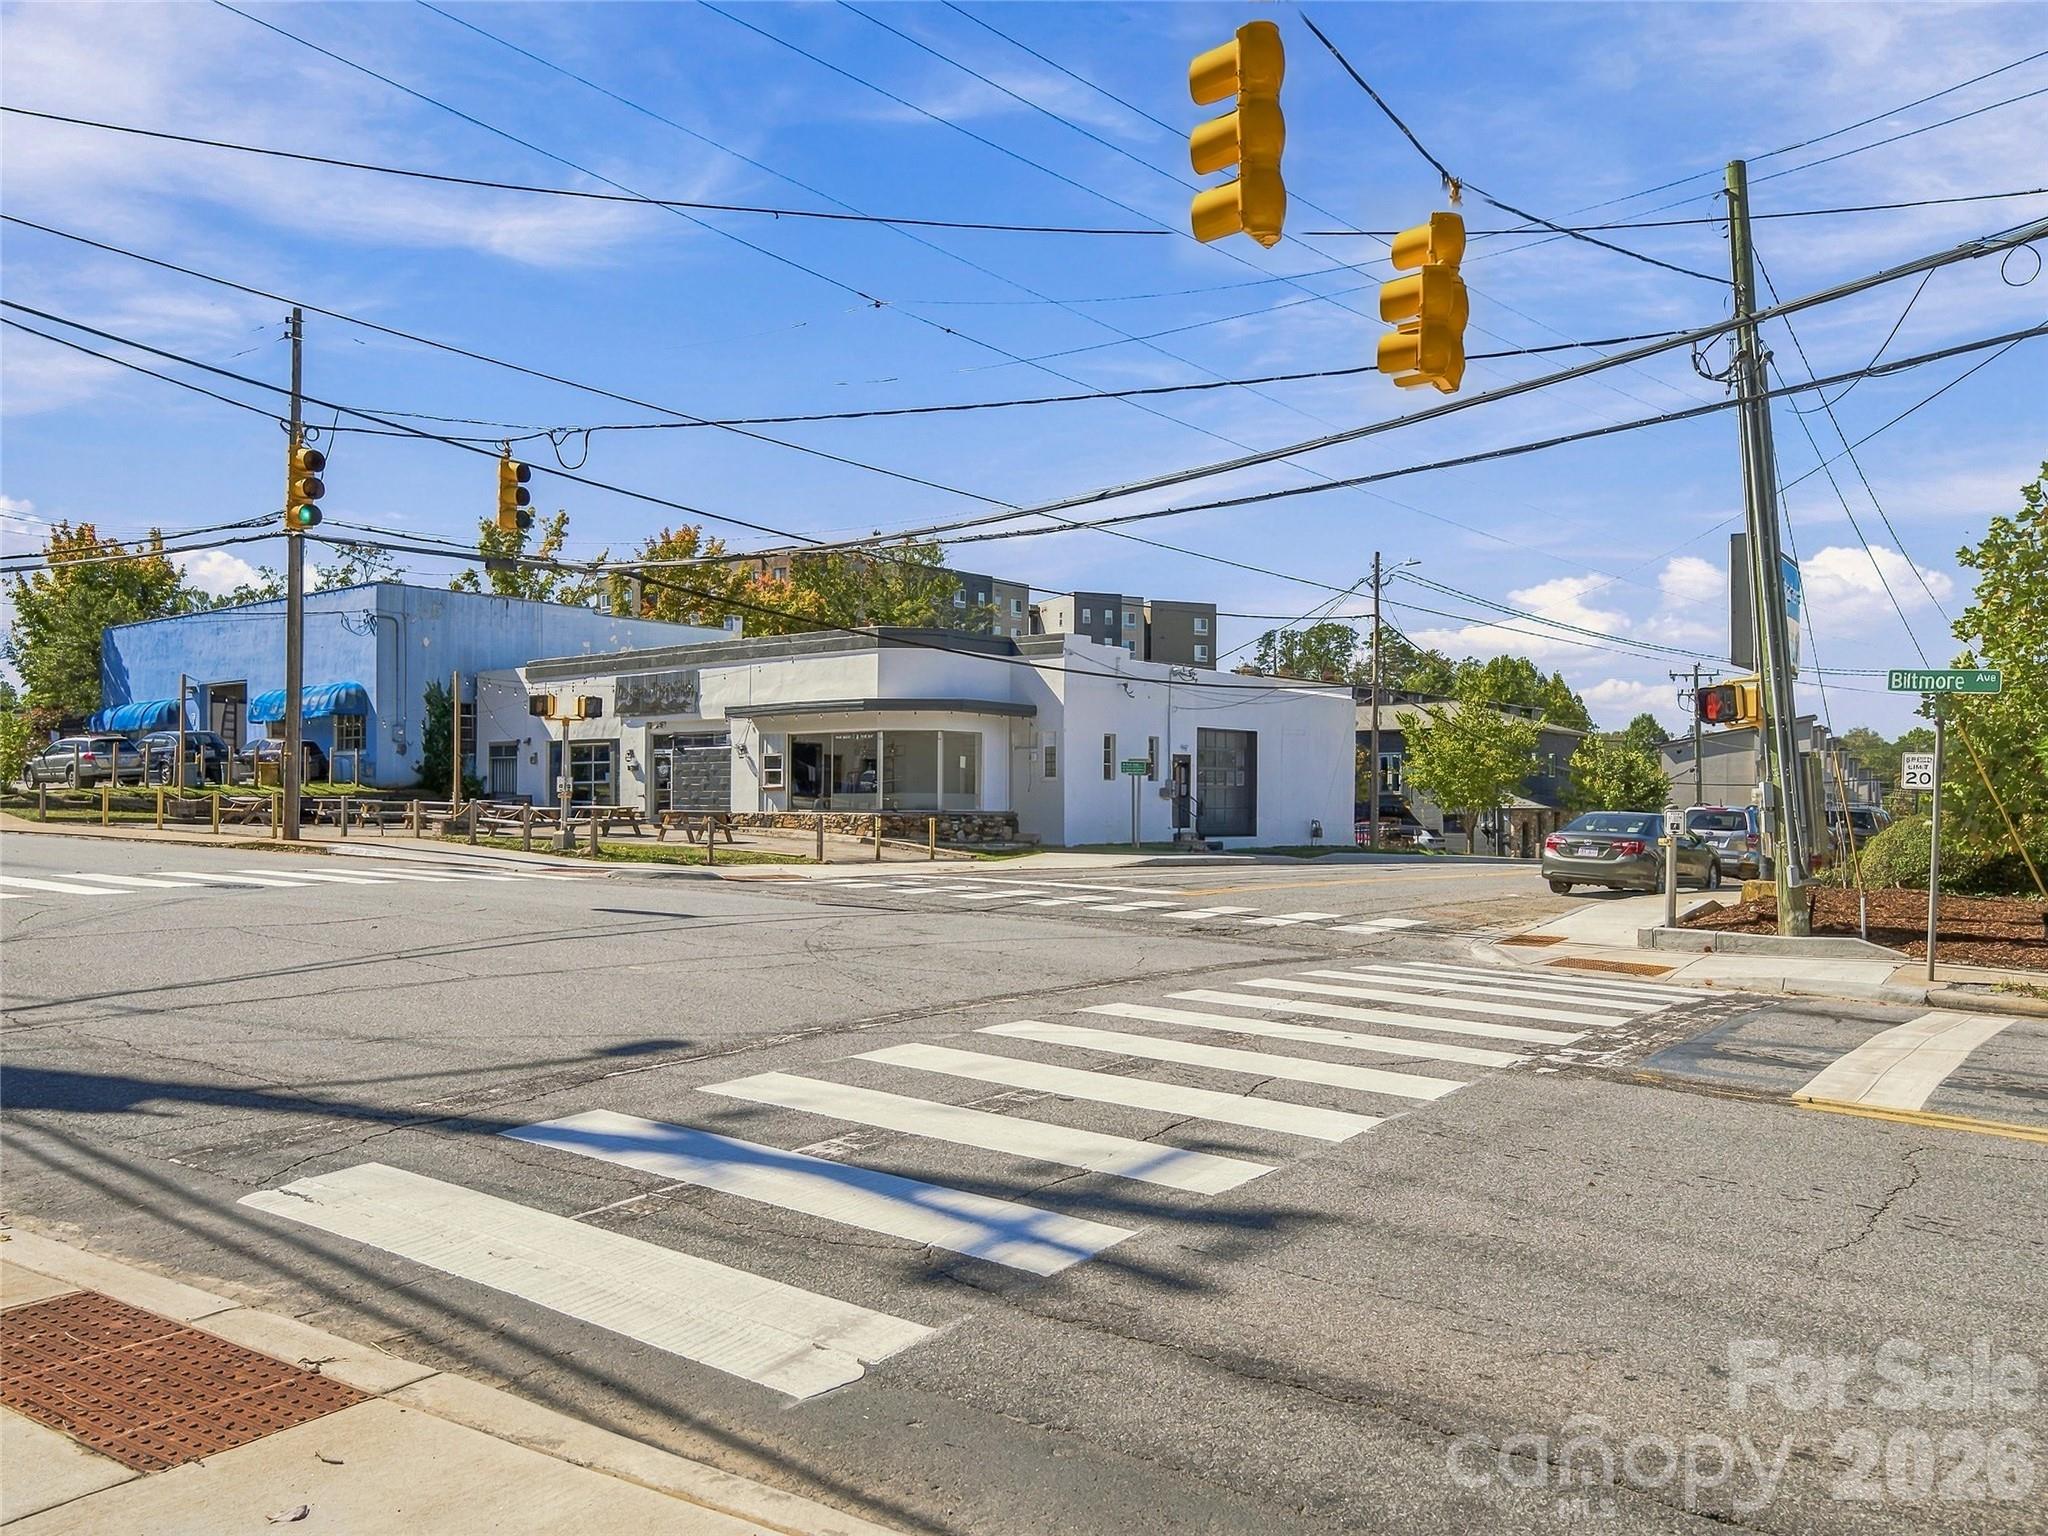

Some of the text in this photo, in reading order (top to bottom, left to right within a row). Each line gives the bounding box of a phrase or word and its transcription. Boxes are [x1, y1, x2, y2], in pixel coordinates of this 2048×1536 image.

[1891, 672, 1997, 690] Biltmore Ave
[1905, 772, 1932, 785] 20
